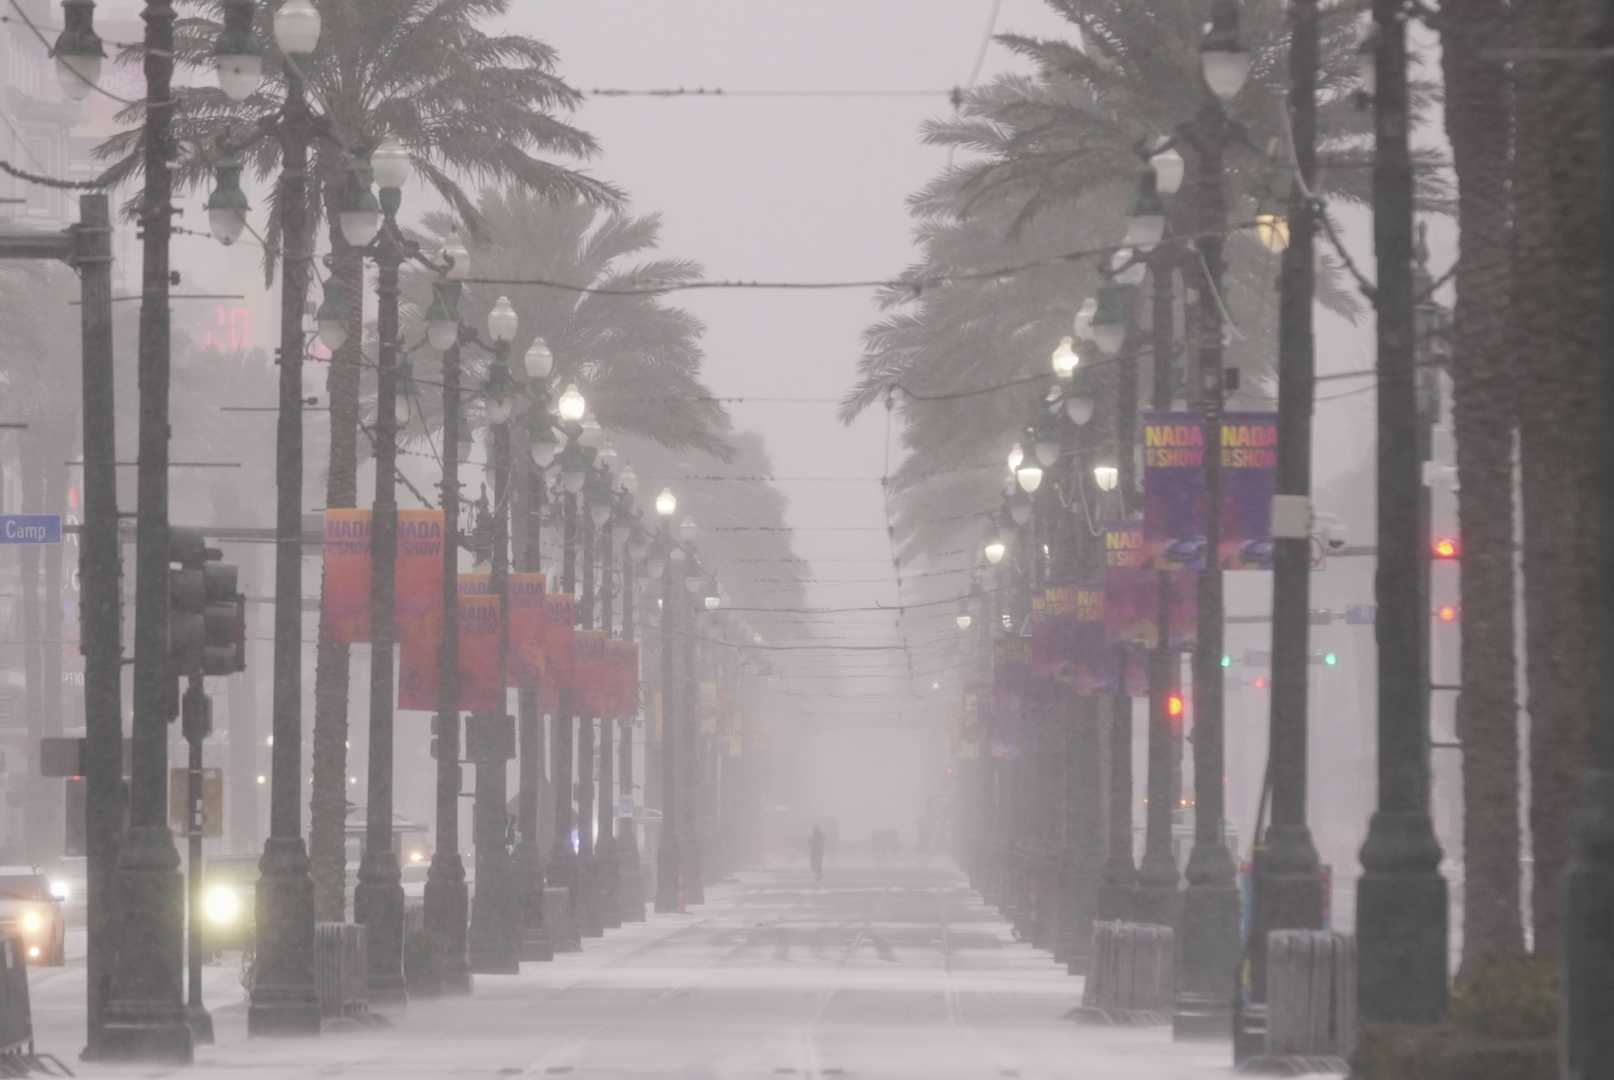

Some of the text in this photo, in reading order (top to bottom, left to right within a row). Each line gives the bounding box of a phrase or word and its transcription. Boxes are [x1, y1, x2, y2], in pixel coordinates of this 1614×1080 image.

[1145, 425, 1203, 446] NADA
[1220, 425, 1277, 446] NADA
[6, 520, 46, 541] Camp
